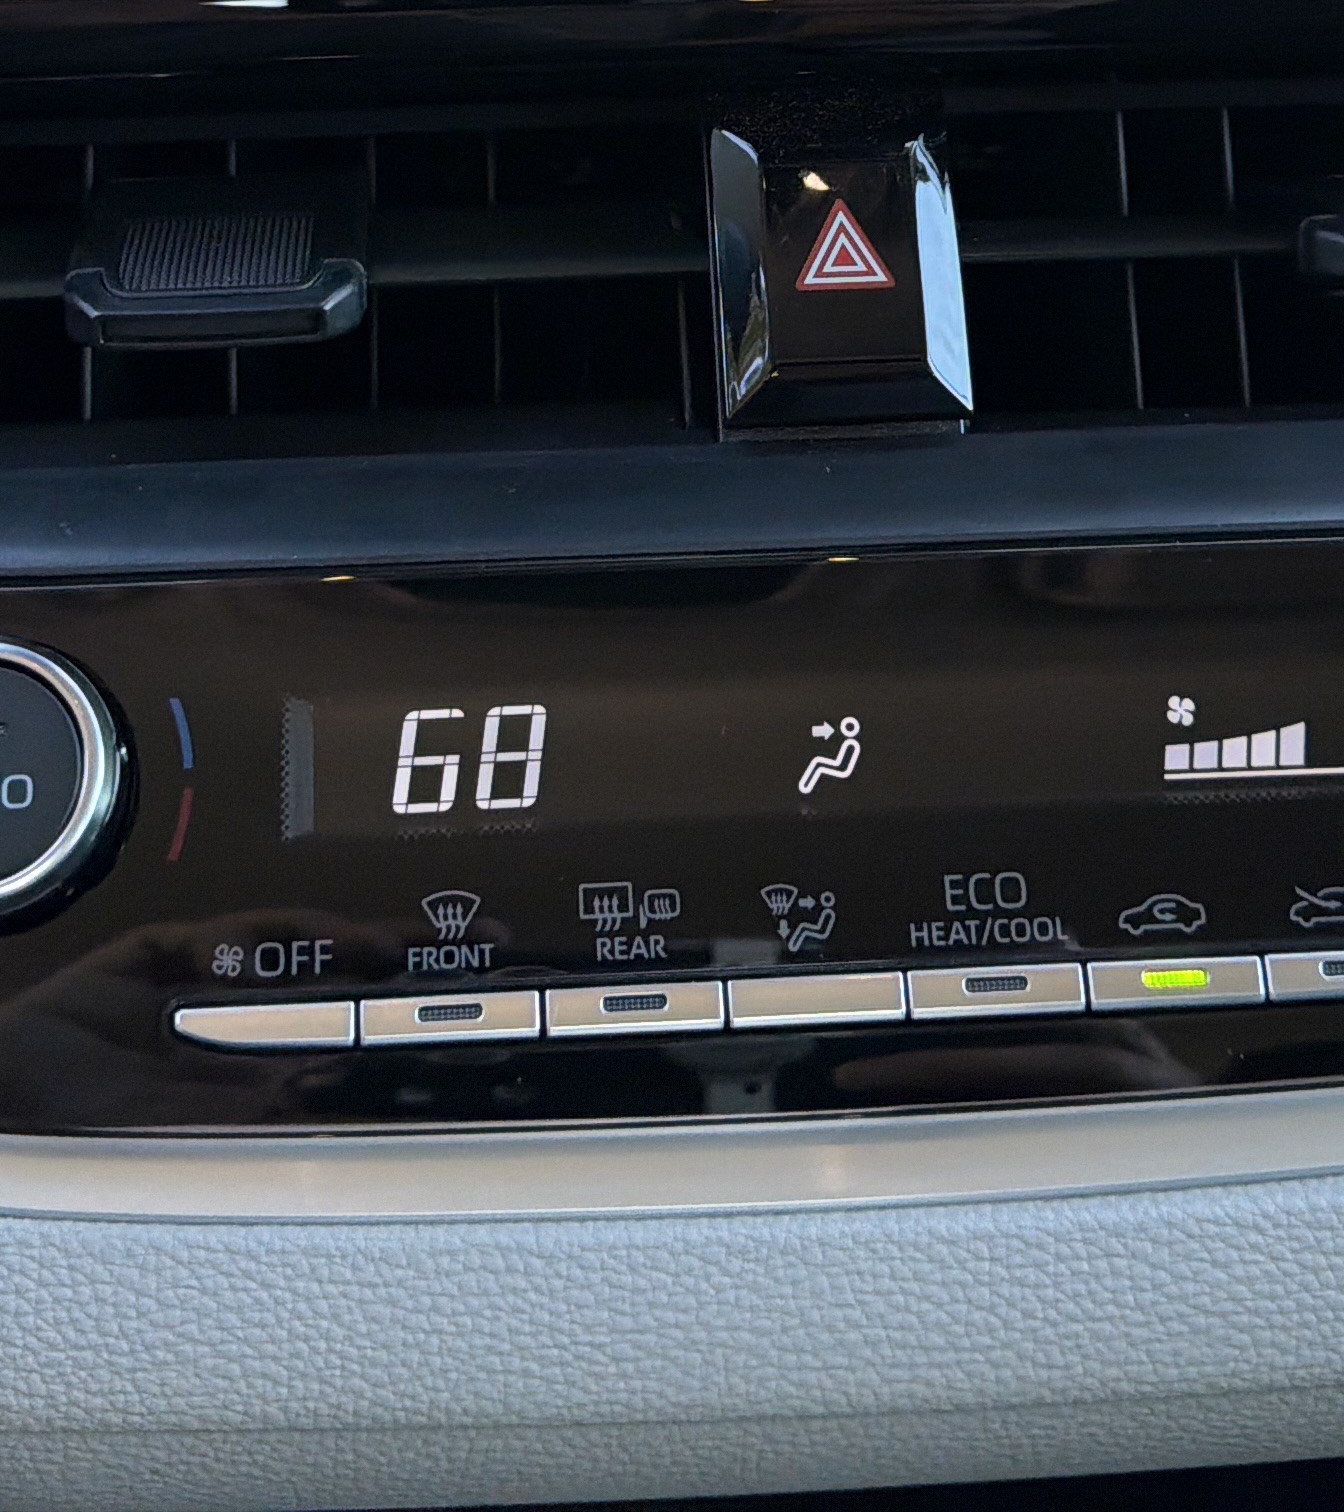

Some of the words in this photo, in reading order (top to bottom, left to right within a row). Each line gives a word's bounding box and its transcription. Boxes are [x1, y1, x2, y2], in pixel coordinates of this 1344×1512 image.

[392, 703, 547, 815] 68
[943, 871, 1027, 911] ECO
[596, 935, 669, 962] REAR
[909, 916, 1069, 948] HEAT/COOL
[255, 940, 334, 978] OFF
[407, 943, 495, 971] FRONT
